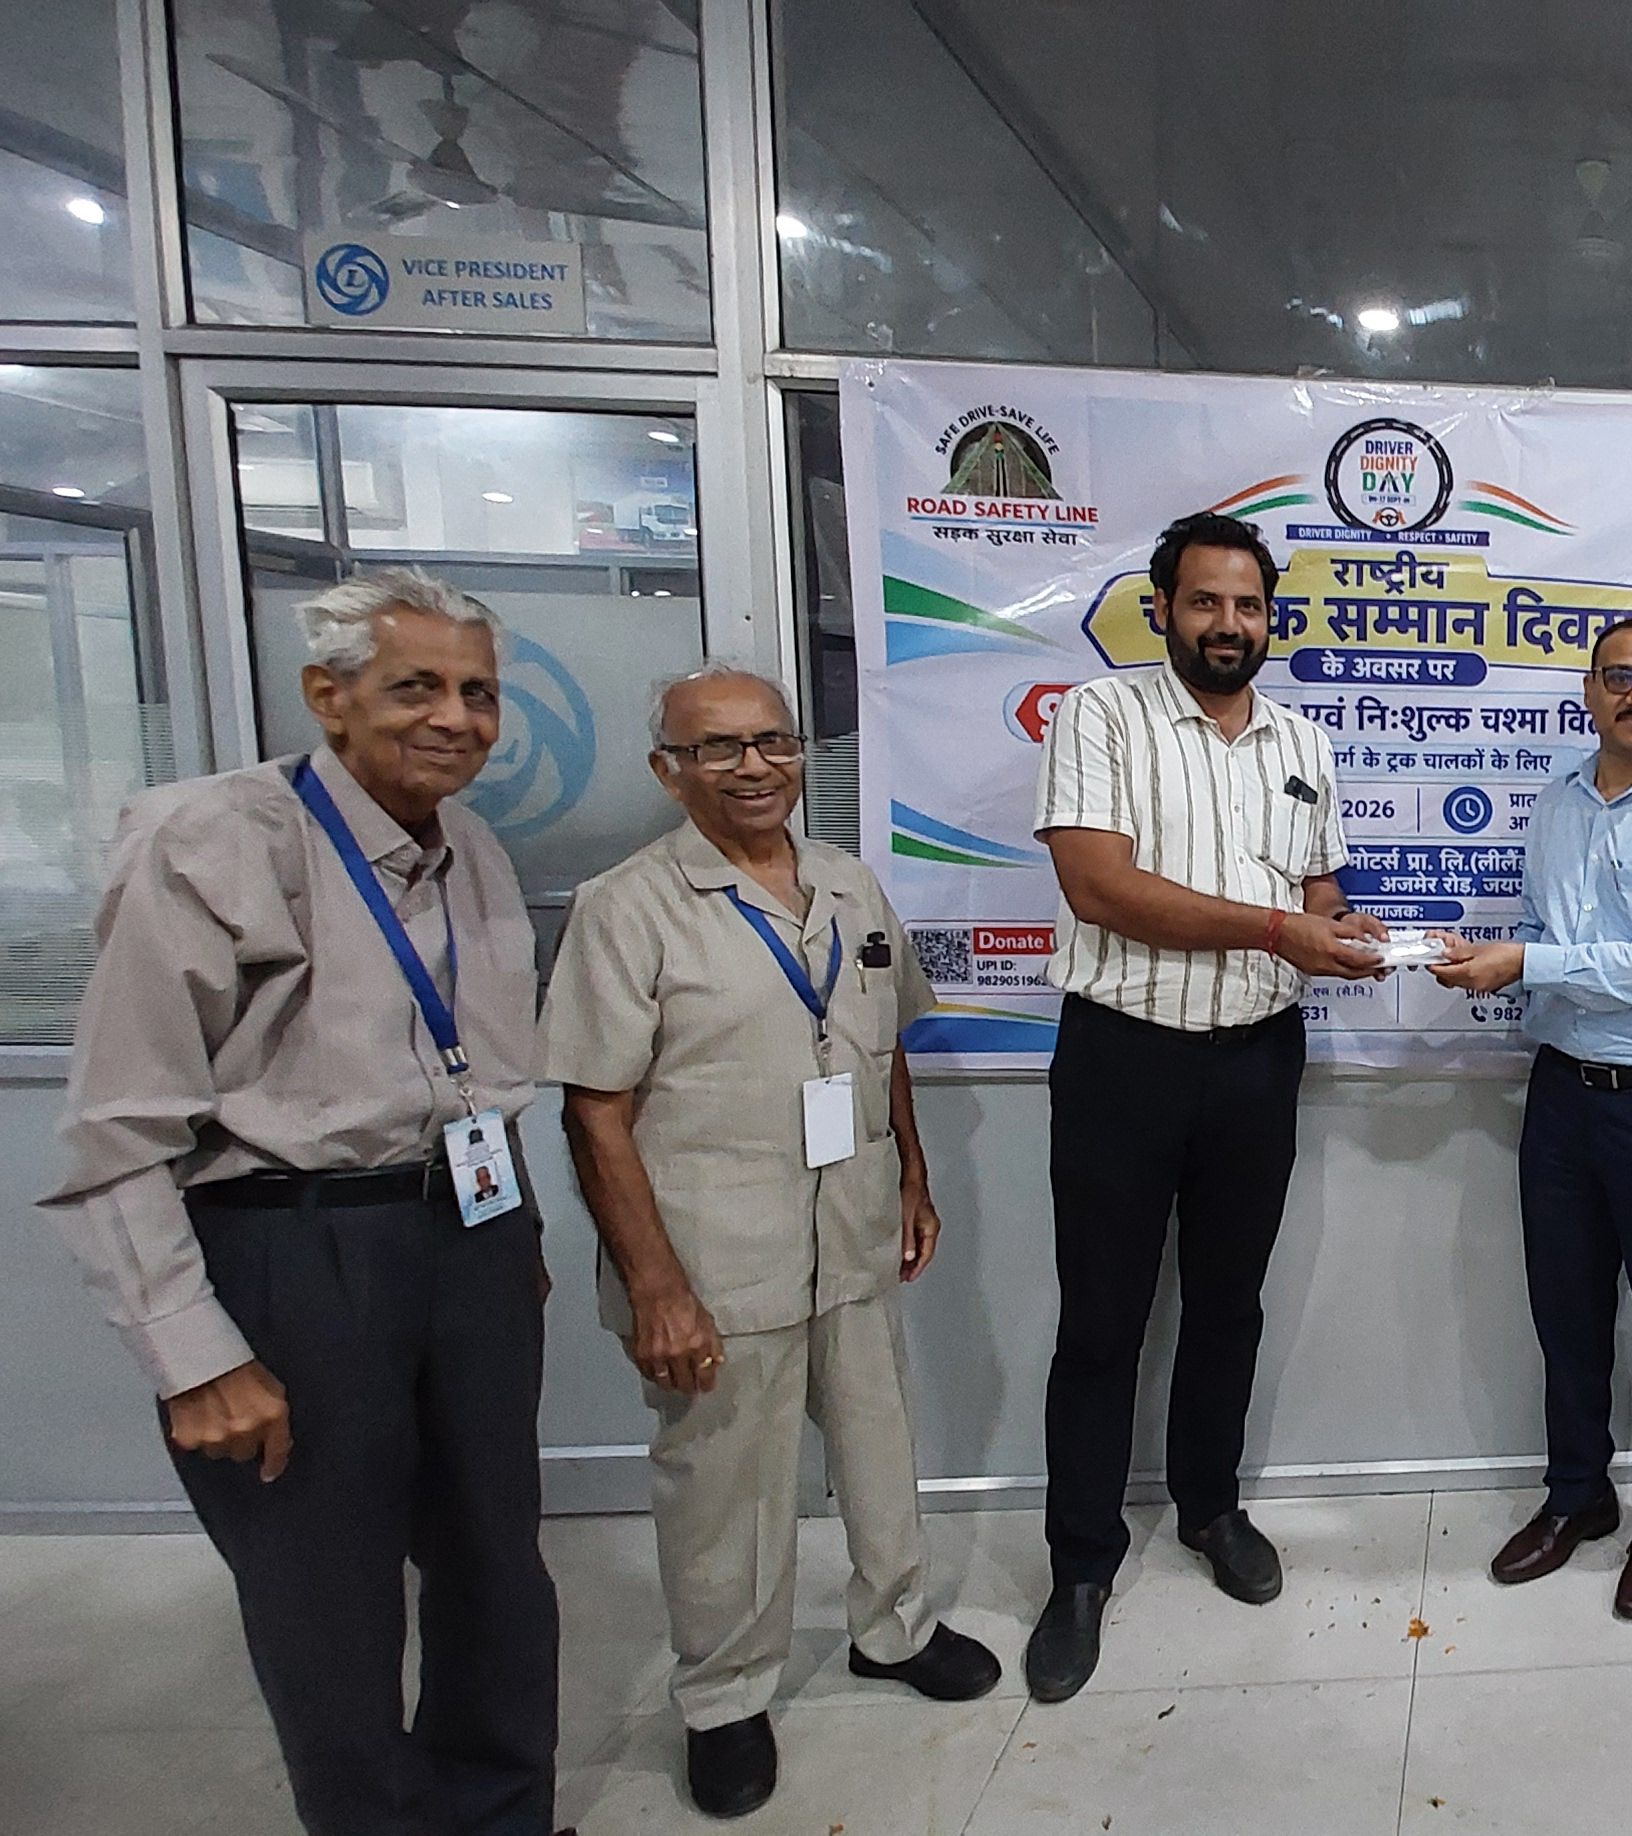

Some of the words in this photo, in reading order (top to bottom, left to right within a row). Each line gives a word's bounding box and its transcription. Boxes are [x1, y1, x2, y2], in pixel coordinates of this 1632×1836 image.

[402, 258, 448, 277] VICE
[455, 260, 568, 281] PRESIDENT
[422, 289, 486, 308] AFTER
[492, 291, 552, 310] SALES
[935, 424, 960, 456] SAFE
[1034, 425, 1060, 456] LIFE
[1365, 440, 1413, 455] DRIVER
[1360, 456, 1418, 471] DIGNITY
[1362, 471, 1415, 493] DAY
[907, 497, 967, 515] ROAD
[974, 501, 1049, 521] SAFETY
[1055, 506, 1099, 523] LINE
[985, 529, 1035, 546] सुरक्षा
[1041, 528, 1077, 546] सेवा
[1299, 528, 1332, 540] DRIVER
[1334, 529, 1372, 541] DIGNITY
[1398, 531, 1436, 543] RESPECT
[1444, 533, 1479, 544] SAFETY
[1330, 551, 1450, 595] राष्ट्रीय
[1324, 597, 1490, 646] सम्मान
[1321, 650, 1346, 678] के
[1351, 657, 1422, 680] अवसर
[1426, 659, 1457, 681] पर
[1301, 696, 1346, 731] एवं
[1480, 706, 1549, 735] चश्मा
[1362, 746, 1382, 768] के
[1387, 752, 1418, 773] ट्रक
[1423, 747, 1486, 770] चालकों
[1491, 748, 1510, 770] के
[1516, 749, 1552, 773] लिए
[1341, 799, 1395, 818] 2026
[1406, 852, 1433, 872] प्रा.
[1379, 873, 1438, 894] अजमेर
[978, 931, 1044, 949] Donate
[1460, 926, 1502, 944] सुरक्षा
[977, 960, 997, 971] UPI
[1001, 960, 1017, 971] ID:
